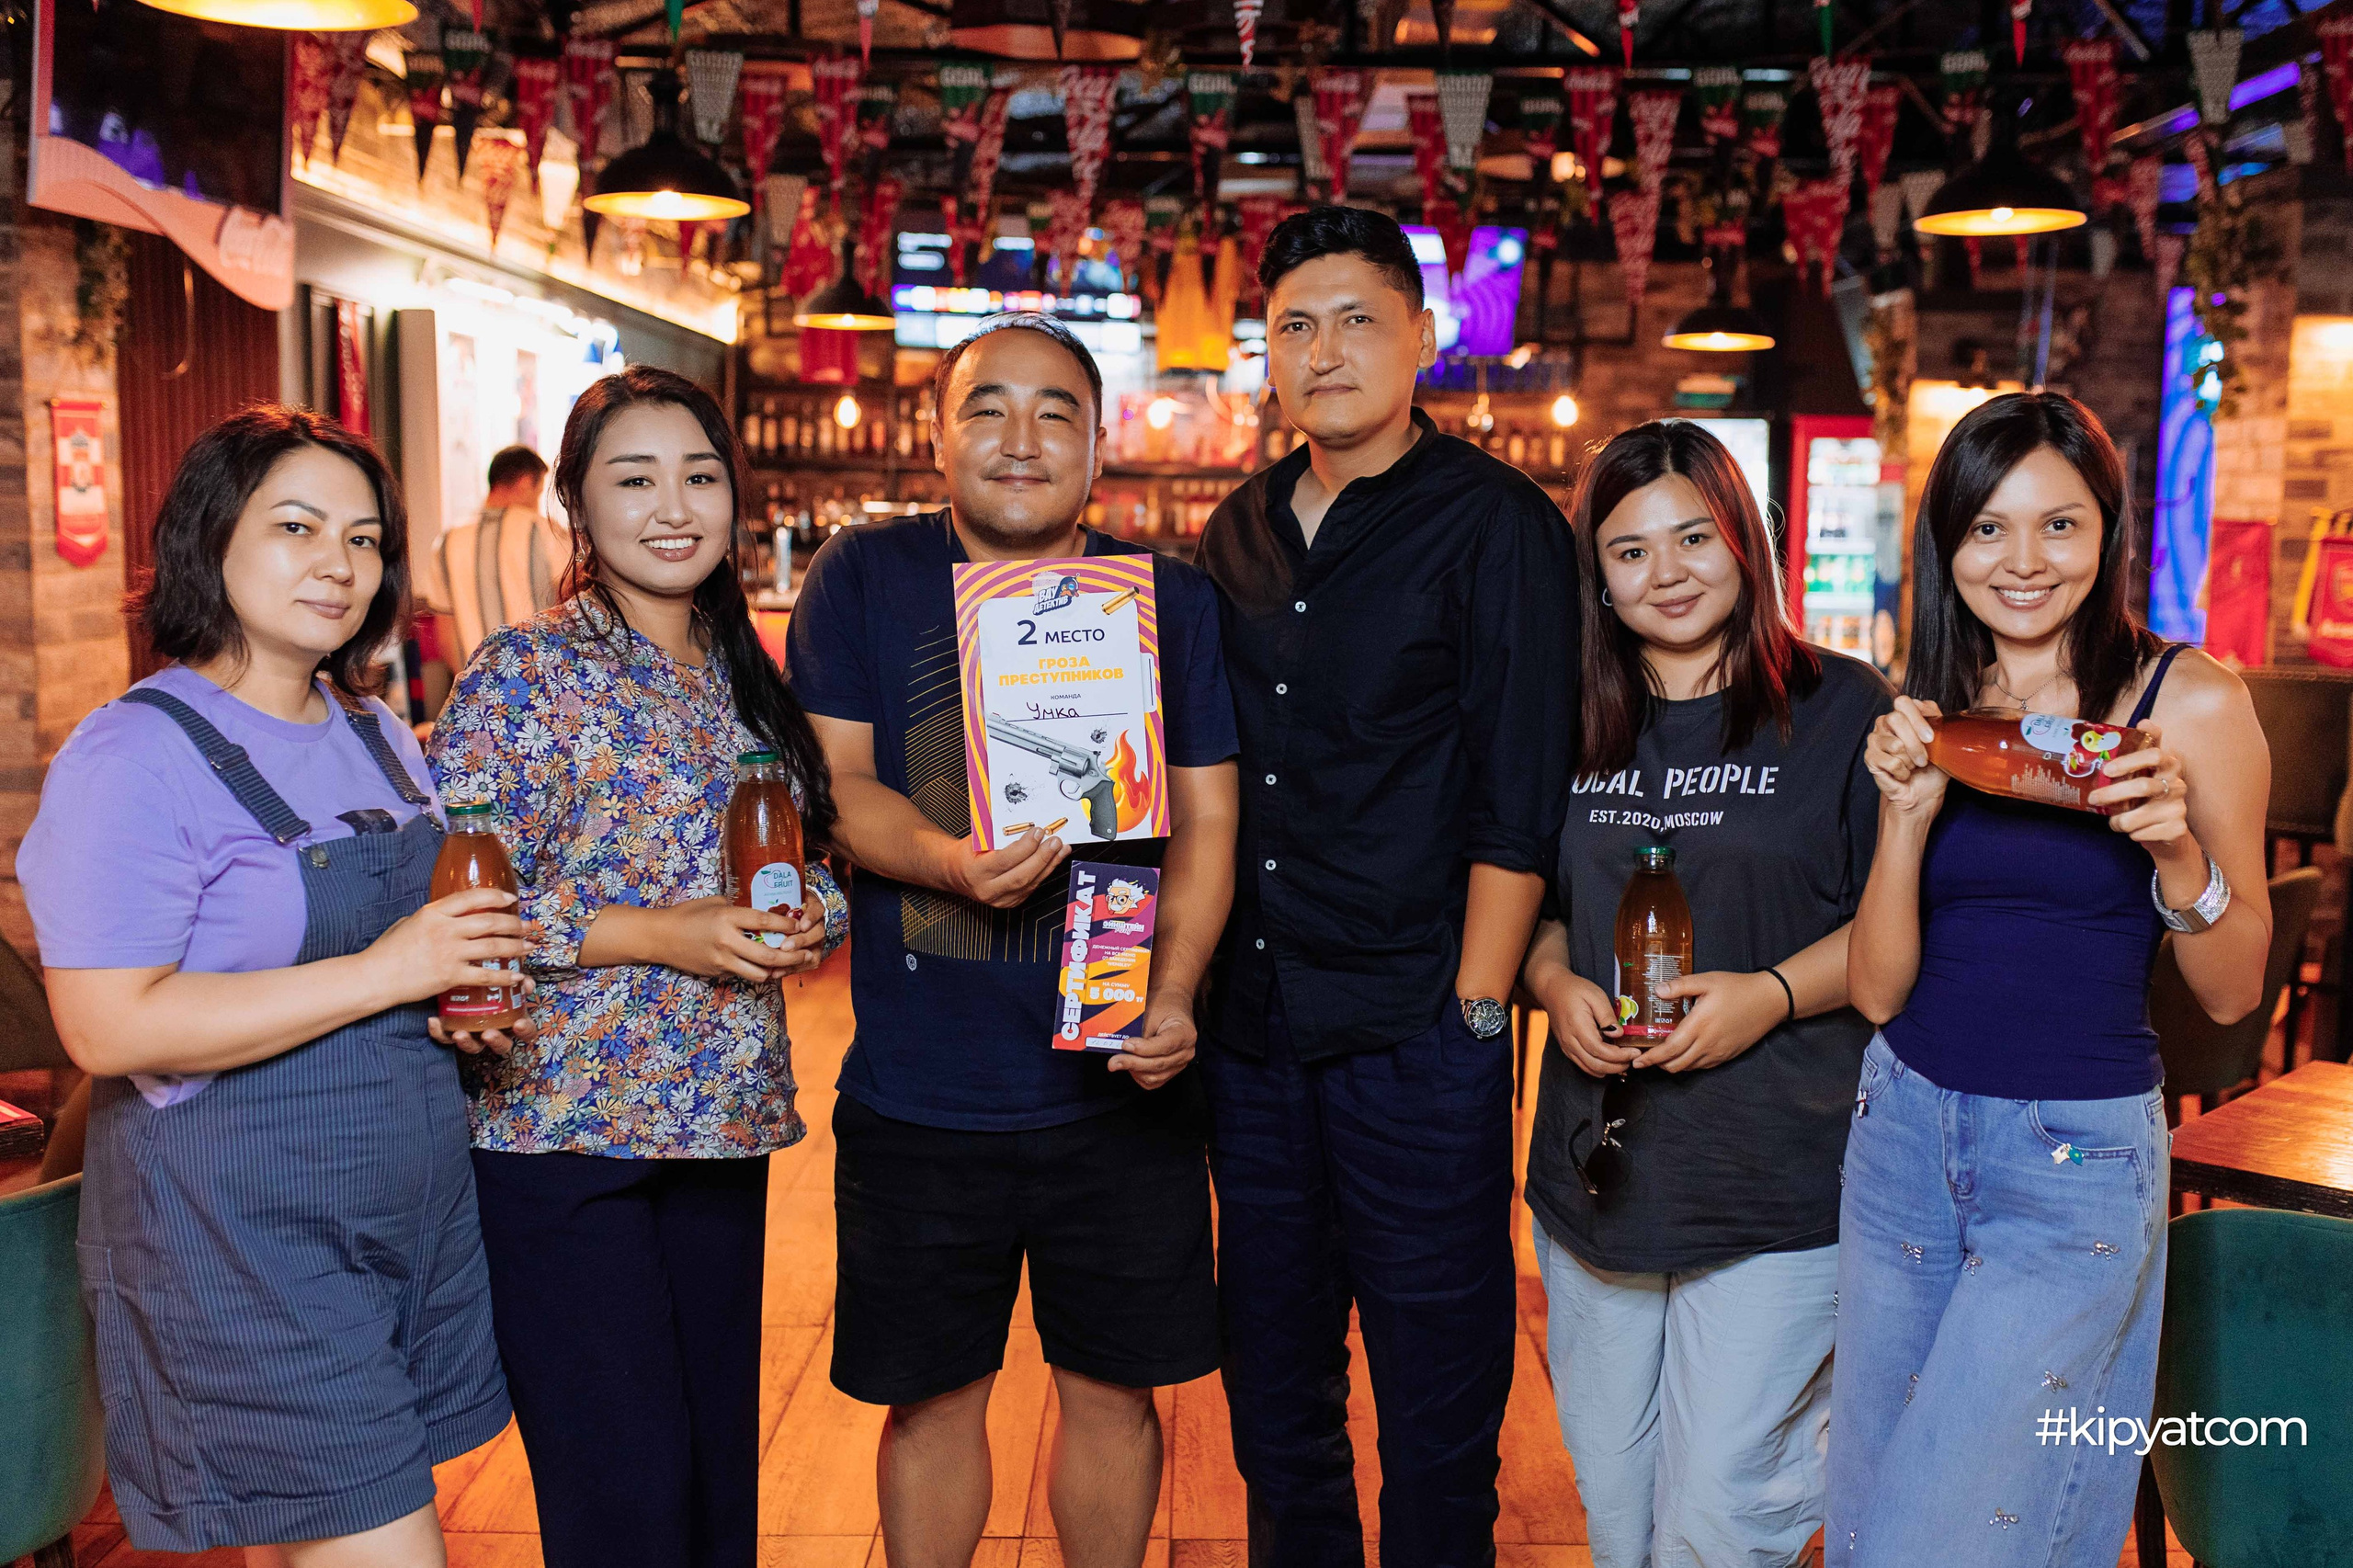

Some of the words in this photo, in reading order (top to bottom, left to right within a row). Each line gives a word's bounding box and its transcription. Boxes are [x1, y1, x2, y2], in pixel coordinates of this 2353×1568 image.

[1039, 585, 1059, 604] ВАУ
[1017, 619, 1038, 645] 2
[1045, 628, 1105, 644] МЕСТО
[1039, 655, 1090, 670] ГРОЗА
[998, 667, 1124, 687] ПРЕСТУПНИКОВ
[1026, 701, 1081, 720] Умка
[1571, 769, 1644, 798] OCAL
[1663, 763, 1779, 800] PEOPLE
[773, 871, 791, 880] DALA
[774, 880, 793, 889] FRUIT
[1061, 870, 1097, 1041] СЕРТИФИКАТ
[1089, 986, 1100, 1000] 5
[1103, 987, 1135, 1003] 000
